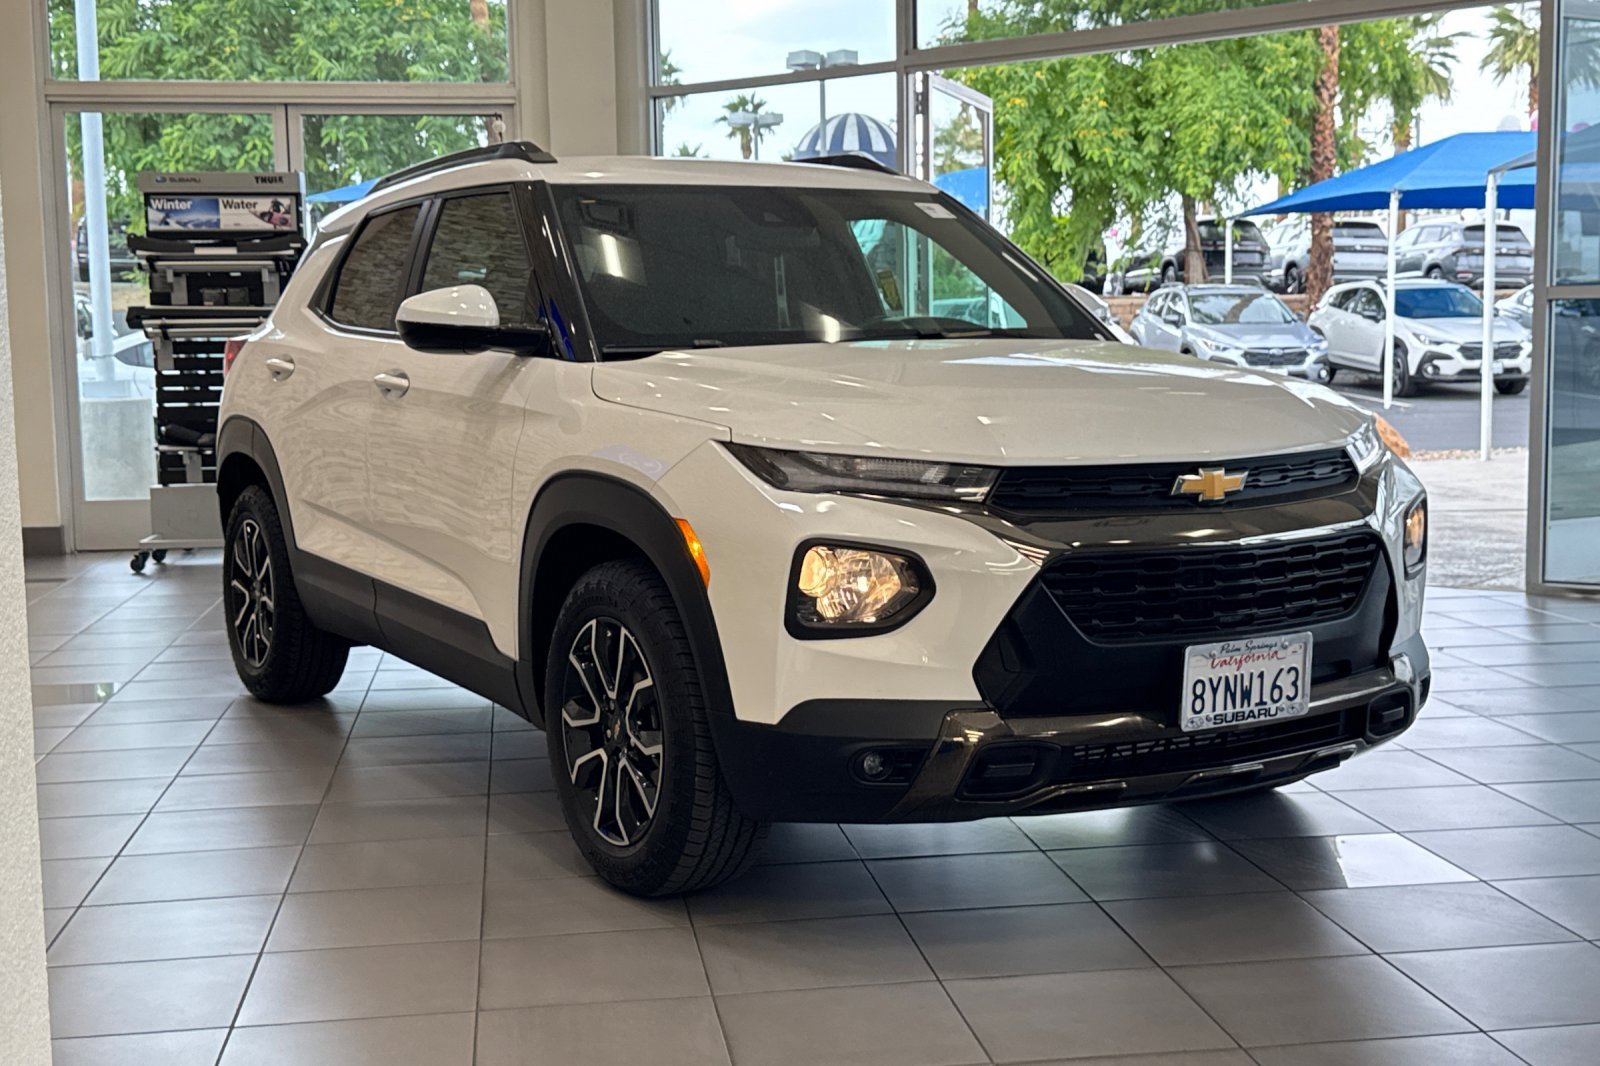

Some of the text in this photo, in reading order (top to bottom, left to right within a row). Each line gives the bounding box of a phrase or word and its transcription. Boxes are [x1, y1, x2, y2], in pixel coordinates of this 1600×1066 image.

[255, 176, 284, 184] THULE
[150, 199, 193, 210] Winter
[221, 199, 258, 210] Water
[1220, 640, 1278, 654] Palm Springs
[1210, 650, 1287, 671] California
[1191, 666, 1300, 715] 8YNW163
[1213, 706, 1279, 725] SUBARU
